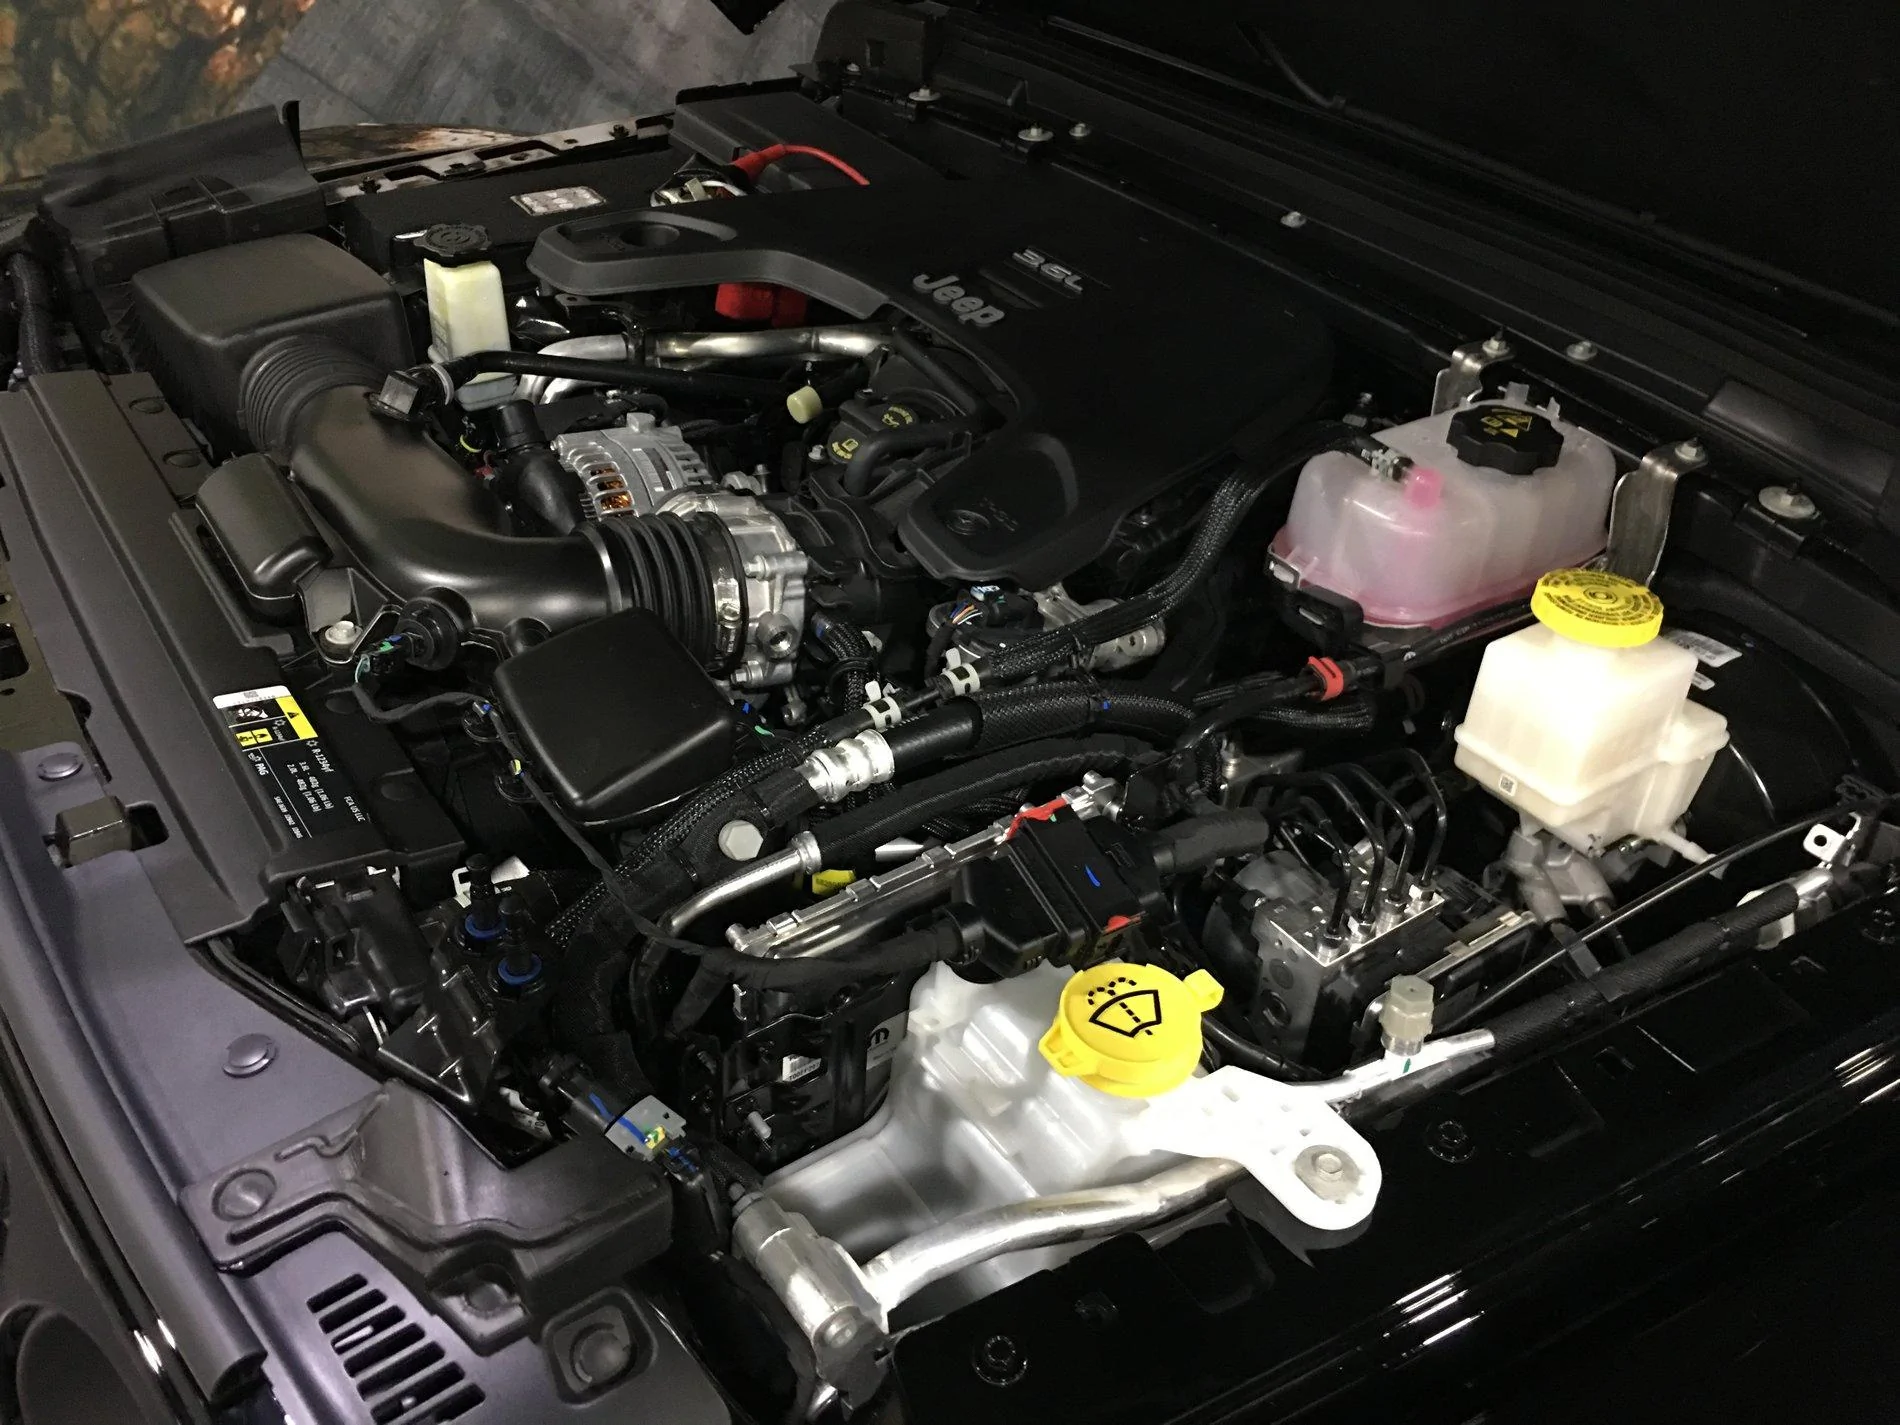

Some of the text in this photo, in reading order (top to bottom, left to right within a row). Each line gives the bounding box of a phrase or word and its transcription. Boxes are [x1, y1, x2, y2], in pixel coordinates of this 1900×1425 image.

[912, 273, 1006, 329] Jeep
[255, 763, 269, 776] PAG
[311, 748, 334, 773] R-1234yf
[344, 795, 354, 806] FCA
[354, 812, 366, 822] LLC
